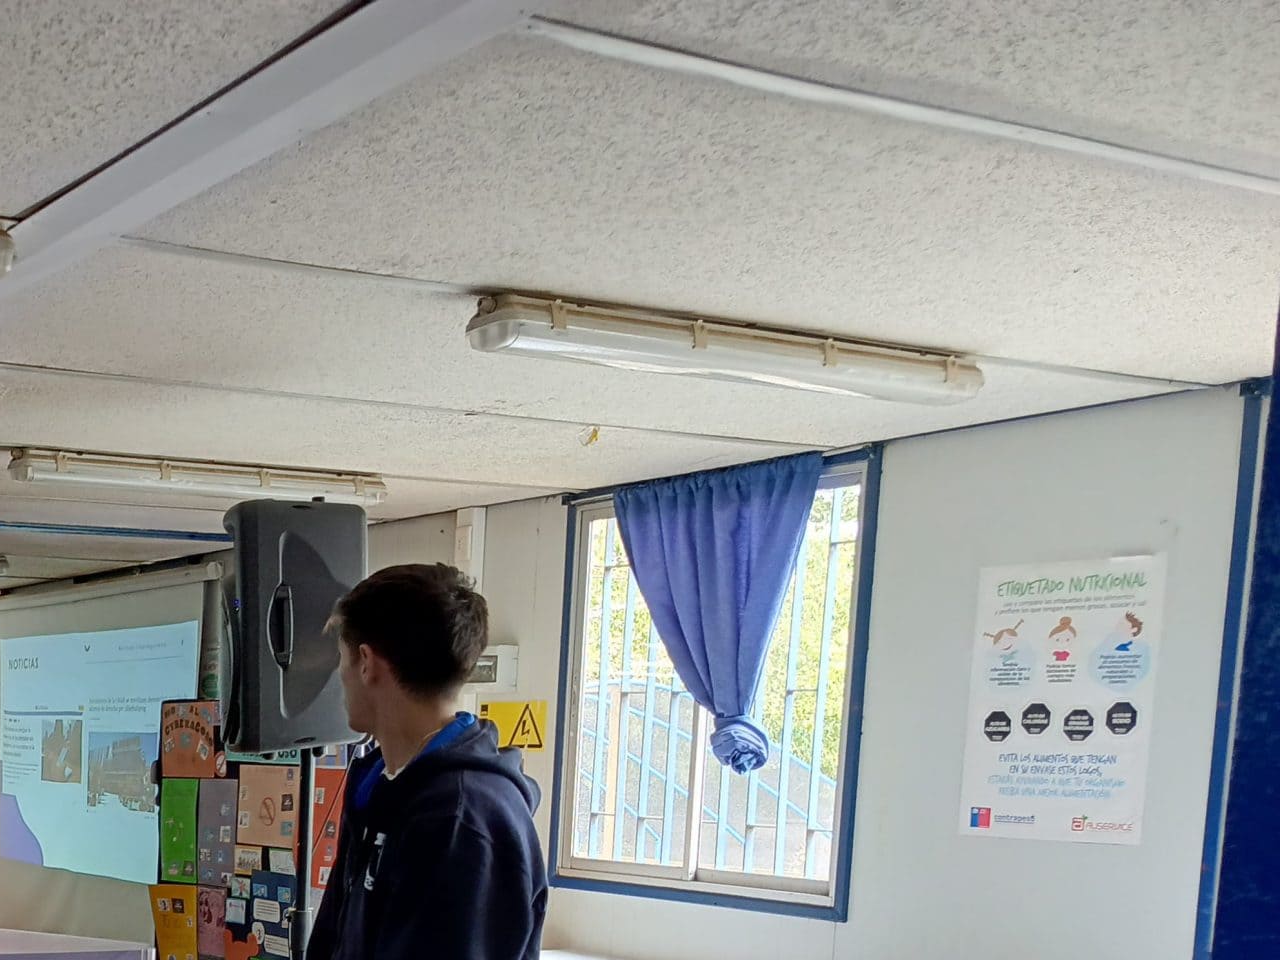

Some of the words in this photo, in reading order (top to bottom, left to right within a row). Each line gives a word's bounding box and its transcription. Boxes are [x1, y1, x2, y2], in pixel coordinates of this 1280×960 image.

[997, 578, 1064, 597] ETIQUETADO
[1069, 572, 1147, 593] NUTRICIONAL
[9, 657, 39, 670] NOTICIAS
[189, 704, 199, 716] AL
[999, 753, 1019, 763] EVITA
[1020, 753, 1031, 763] LOS
[1033, 754, 1068, 764] ALIMENTOS
[1087, 754, 1117, 764] TENGAN
[1009, 765, 1019, 774] EN
[1021, 765, 1029, 774] SU
[1030, 766, 1055, 775] ENVASE
[1058, 765, 1078, 775] ESTOS
